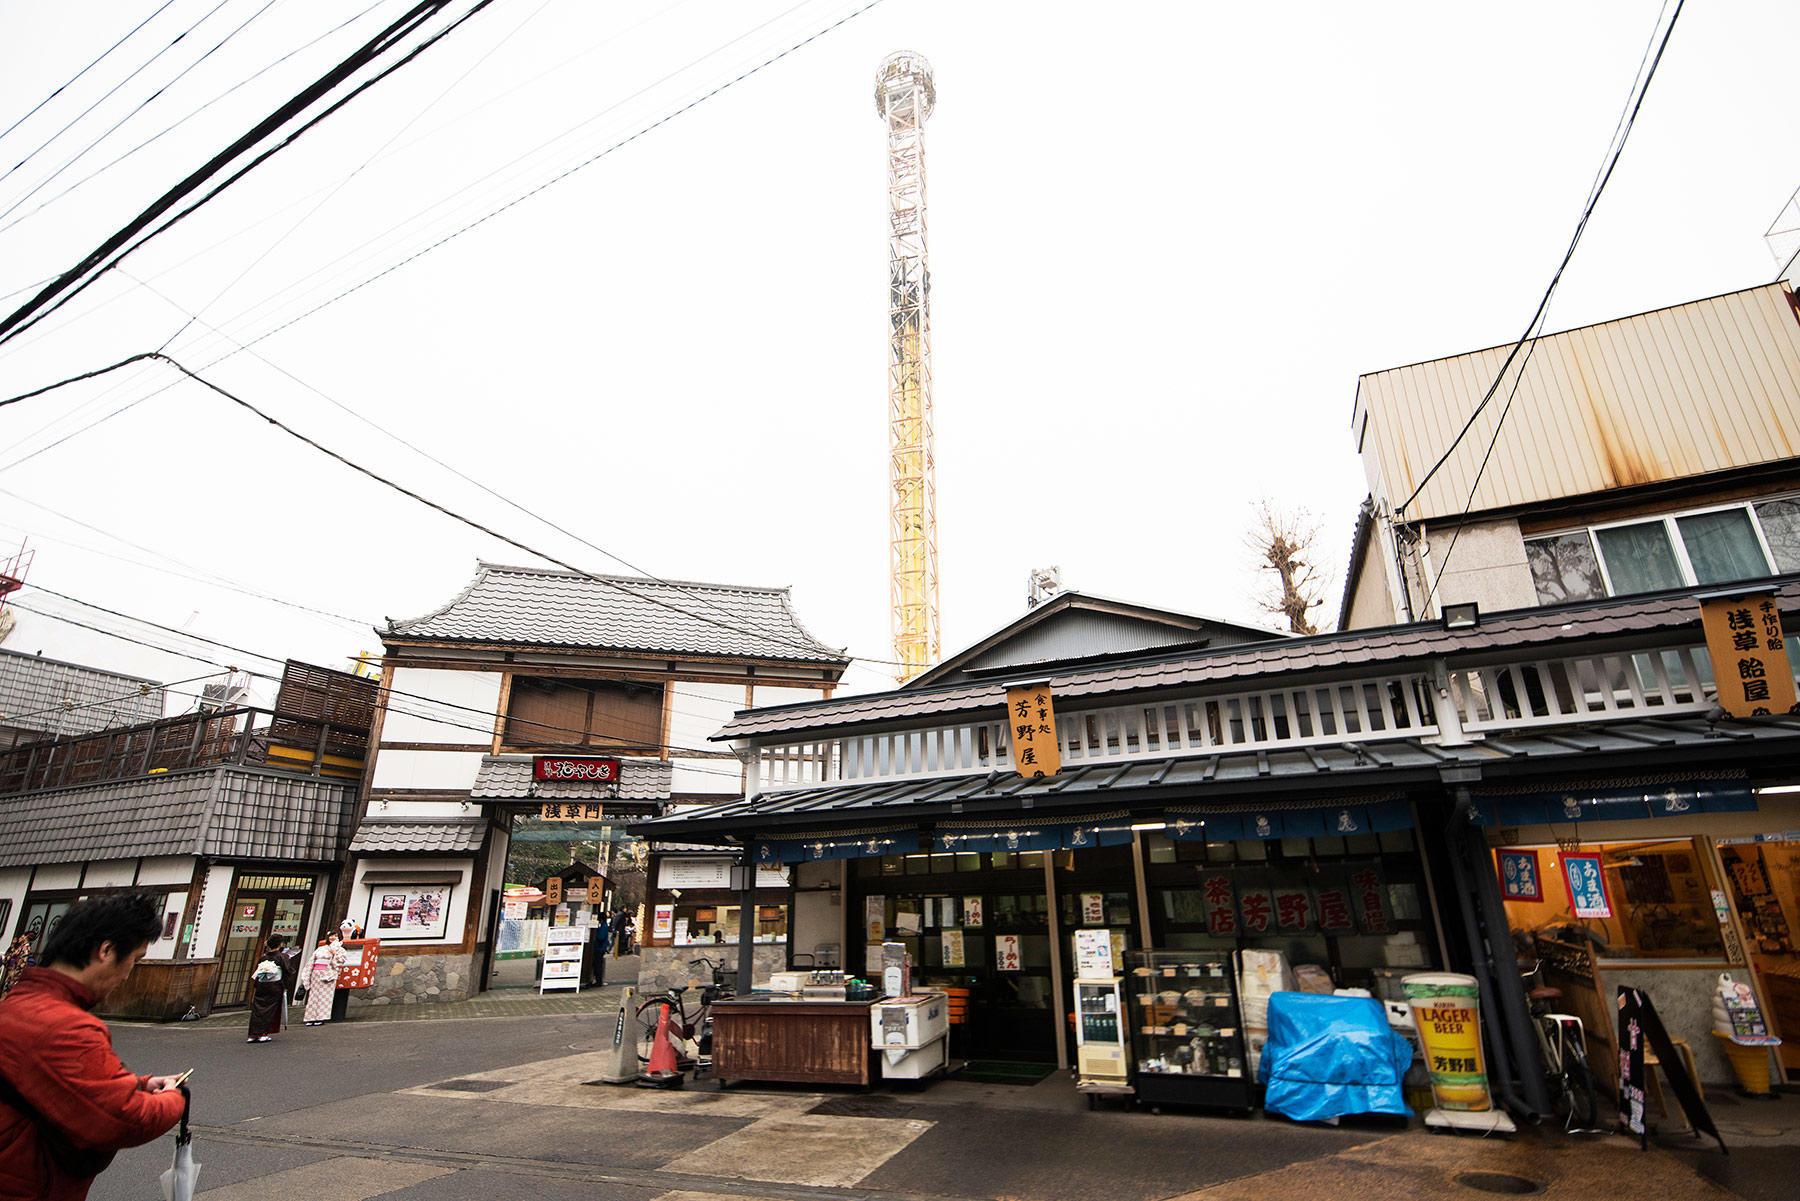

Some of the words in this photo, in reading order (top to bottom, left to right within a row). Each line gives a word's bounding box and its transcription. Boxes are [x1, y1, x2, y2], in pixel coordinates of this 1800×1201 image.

[1759, 601, 1784, 651] 手作り飴
[1727, 608, 1771, 702] 浅草飴屋
[1034, 693, 1051, 734] 食事処
[1015, 700, 1038, 765] 芳野屋
[554, 761, 610, 779] 花やしき
[545, 803, 600, 819] 浅草門
[550, 883, 558, 899] 出口
[591, 882, 600, 898] 入口
[1583, 861, 1605, 909] あま酒
[1204, 876, 1236, 934] 茶店
[1241, 891, 1352, 931] 芳野屋
[1422, 1007, 1471, 1023] LAGER
[1434, 1022, 1464, 1034] BEER
[1434, 1056, 1478, 1073] 芳野屋
